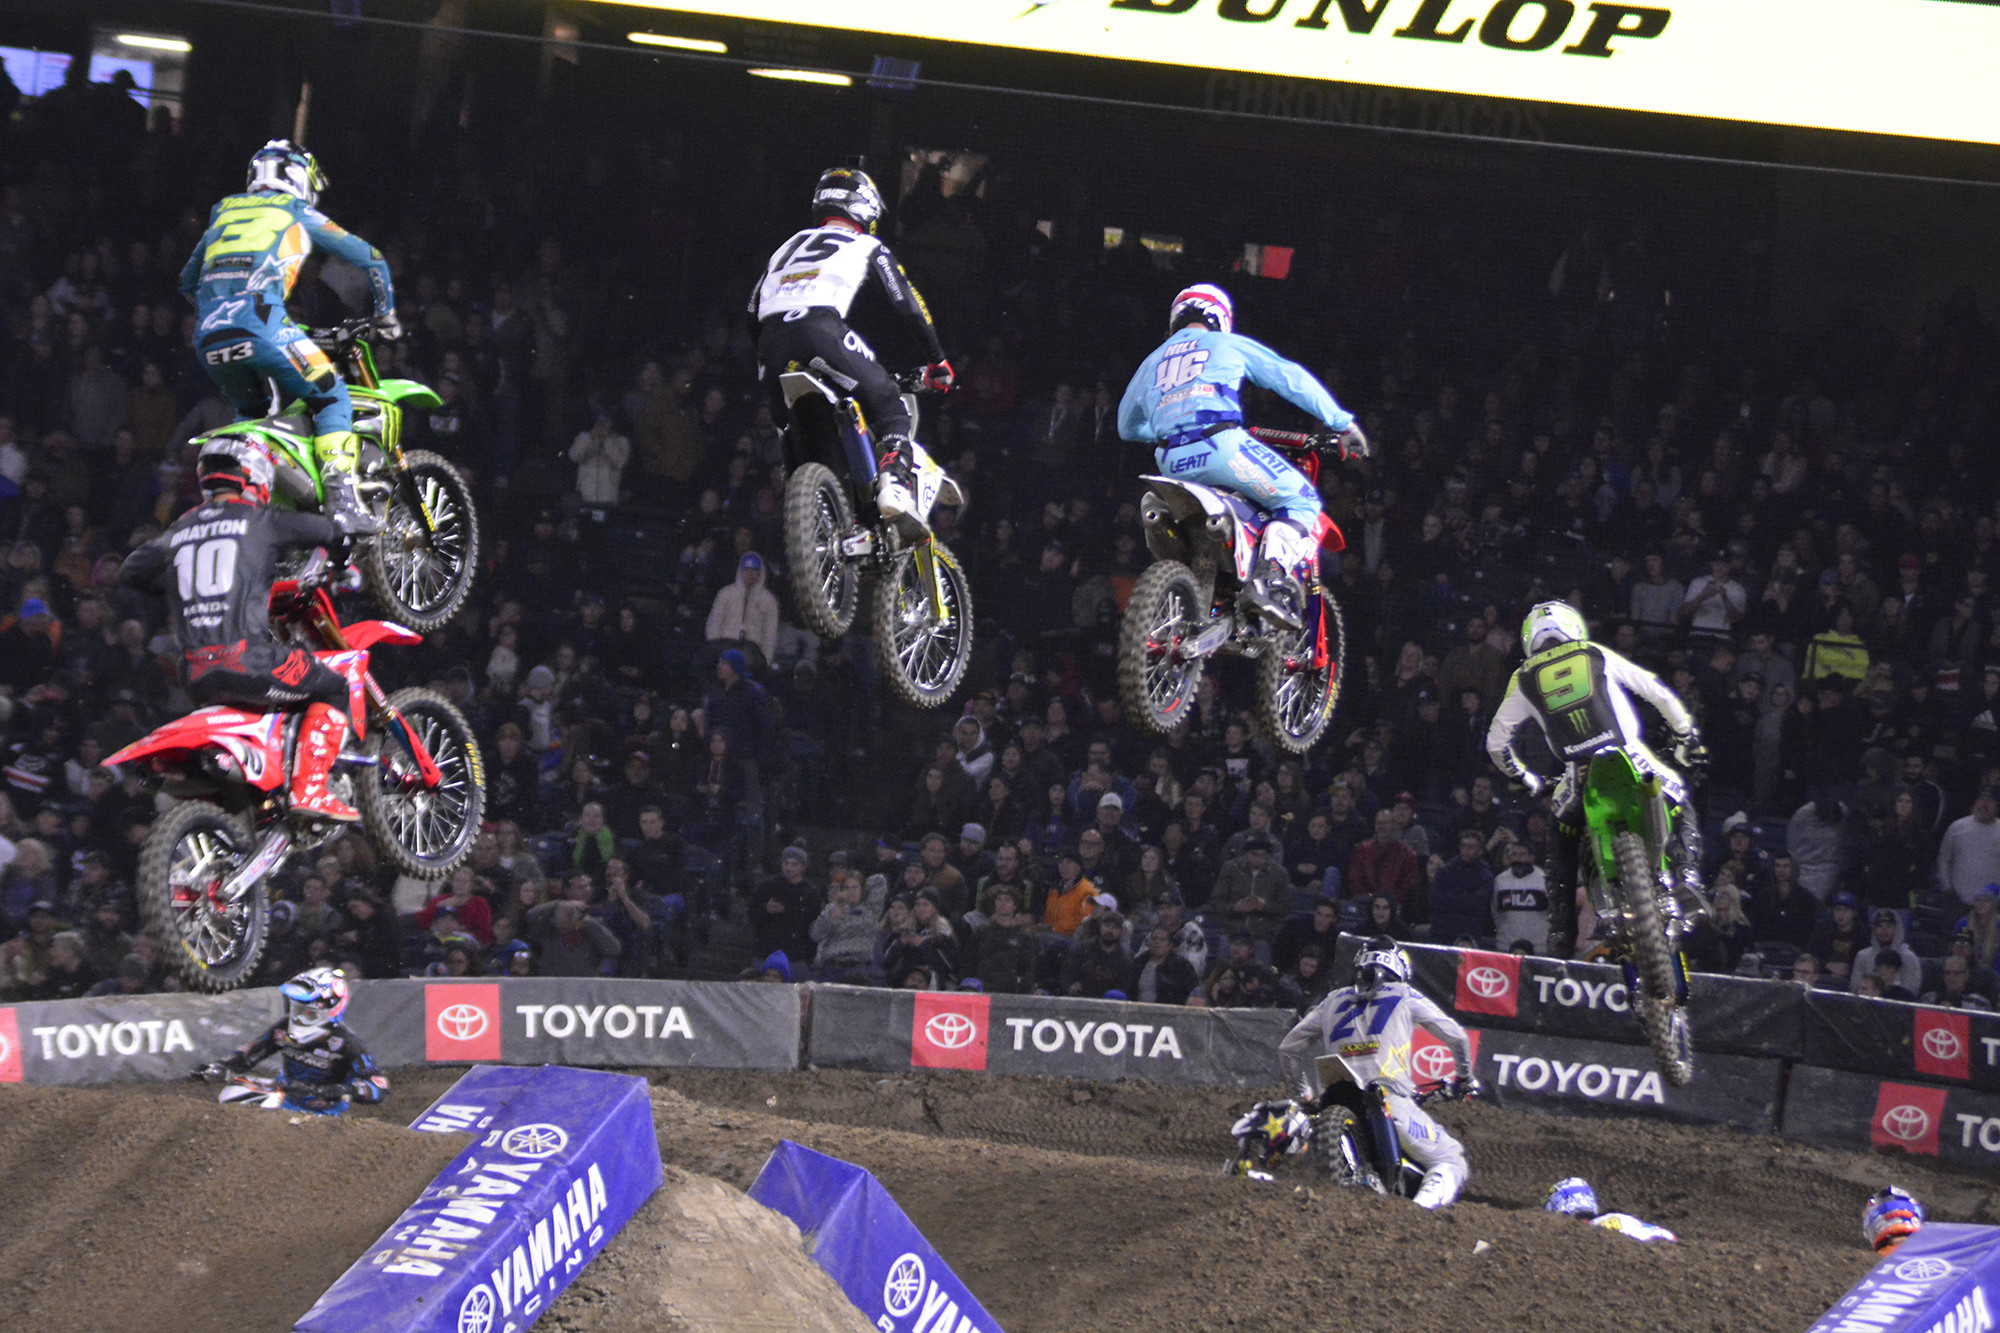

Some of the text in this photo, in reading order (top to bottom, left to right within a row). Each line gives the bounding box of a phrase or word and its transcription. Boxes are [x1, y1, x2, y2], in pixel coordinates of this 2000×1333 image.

[1112, 0, 1671, 58] NLOP
[205, 207, 294, 262] 3
[772, 232, 856, 274] 15
[206, 341, 253, 366] ET3
[1164, 339, 1200, 356] HILL
[1153, 349, 1211, 394] 46
[1170, 451, 1212, 474] LEATT
[169, 519, 248, 548] BRAYTON
[173, 538, 238, 602] 10
[1538, 652, 1593, 714] 9
[1563, 730, 1616, 756] Kawasaki
[1502, 893, 1537, 907] FILA
[32, 1019, 195, 1060] TOYOTA
[515, 1003, 697, 1040] TOYOTA
[1005, 1017, 1183, 1060] TOYOTA
[1492, 1053, 1665, 1104] TOYOTA
[382, 1161, 543, 1277] YAMAHA
[491, 1163, 608, 1318] YAMAHA
